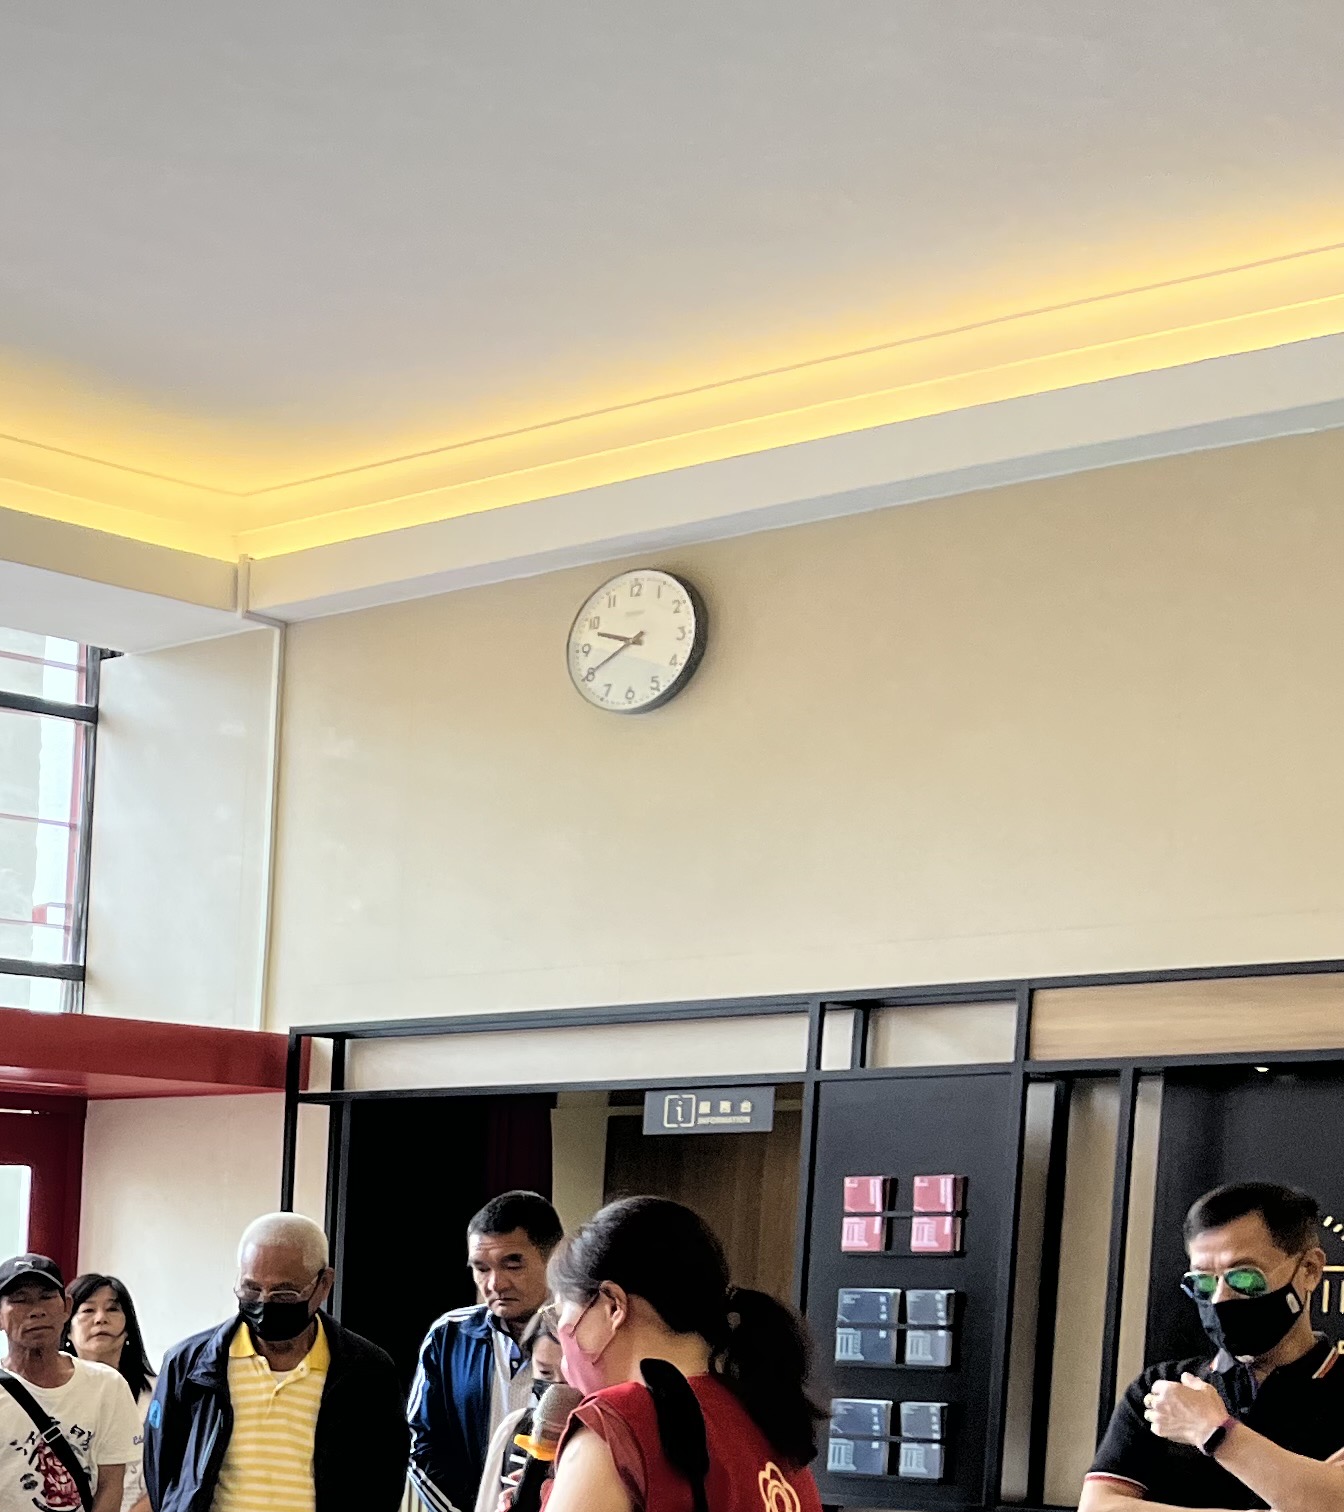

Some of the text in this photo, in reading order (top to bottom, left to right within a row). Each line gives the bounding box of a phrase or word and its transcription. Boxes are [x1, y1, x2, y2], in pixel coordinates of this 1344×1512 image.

[630, 583, 643, 598] 12
[608, 594, 616, 608] 11
[673, 600, 682, 614] 2
[589, 616, 600, 630] 10
[676, 626, 686, 641] 3
[582, 643, 591, 657] 9
[669, 654, 678, 667] 4
[586, 667, 595, 682] 8
[650, 675, 660, 690] 5
[604, 684, 612, 697] 7
[625, 686, 635, 700] 6
